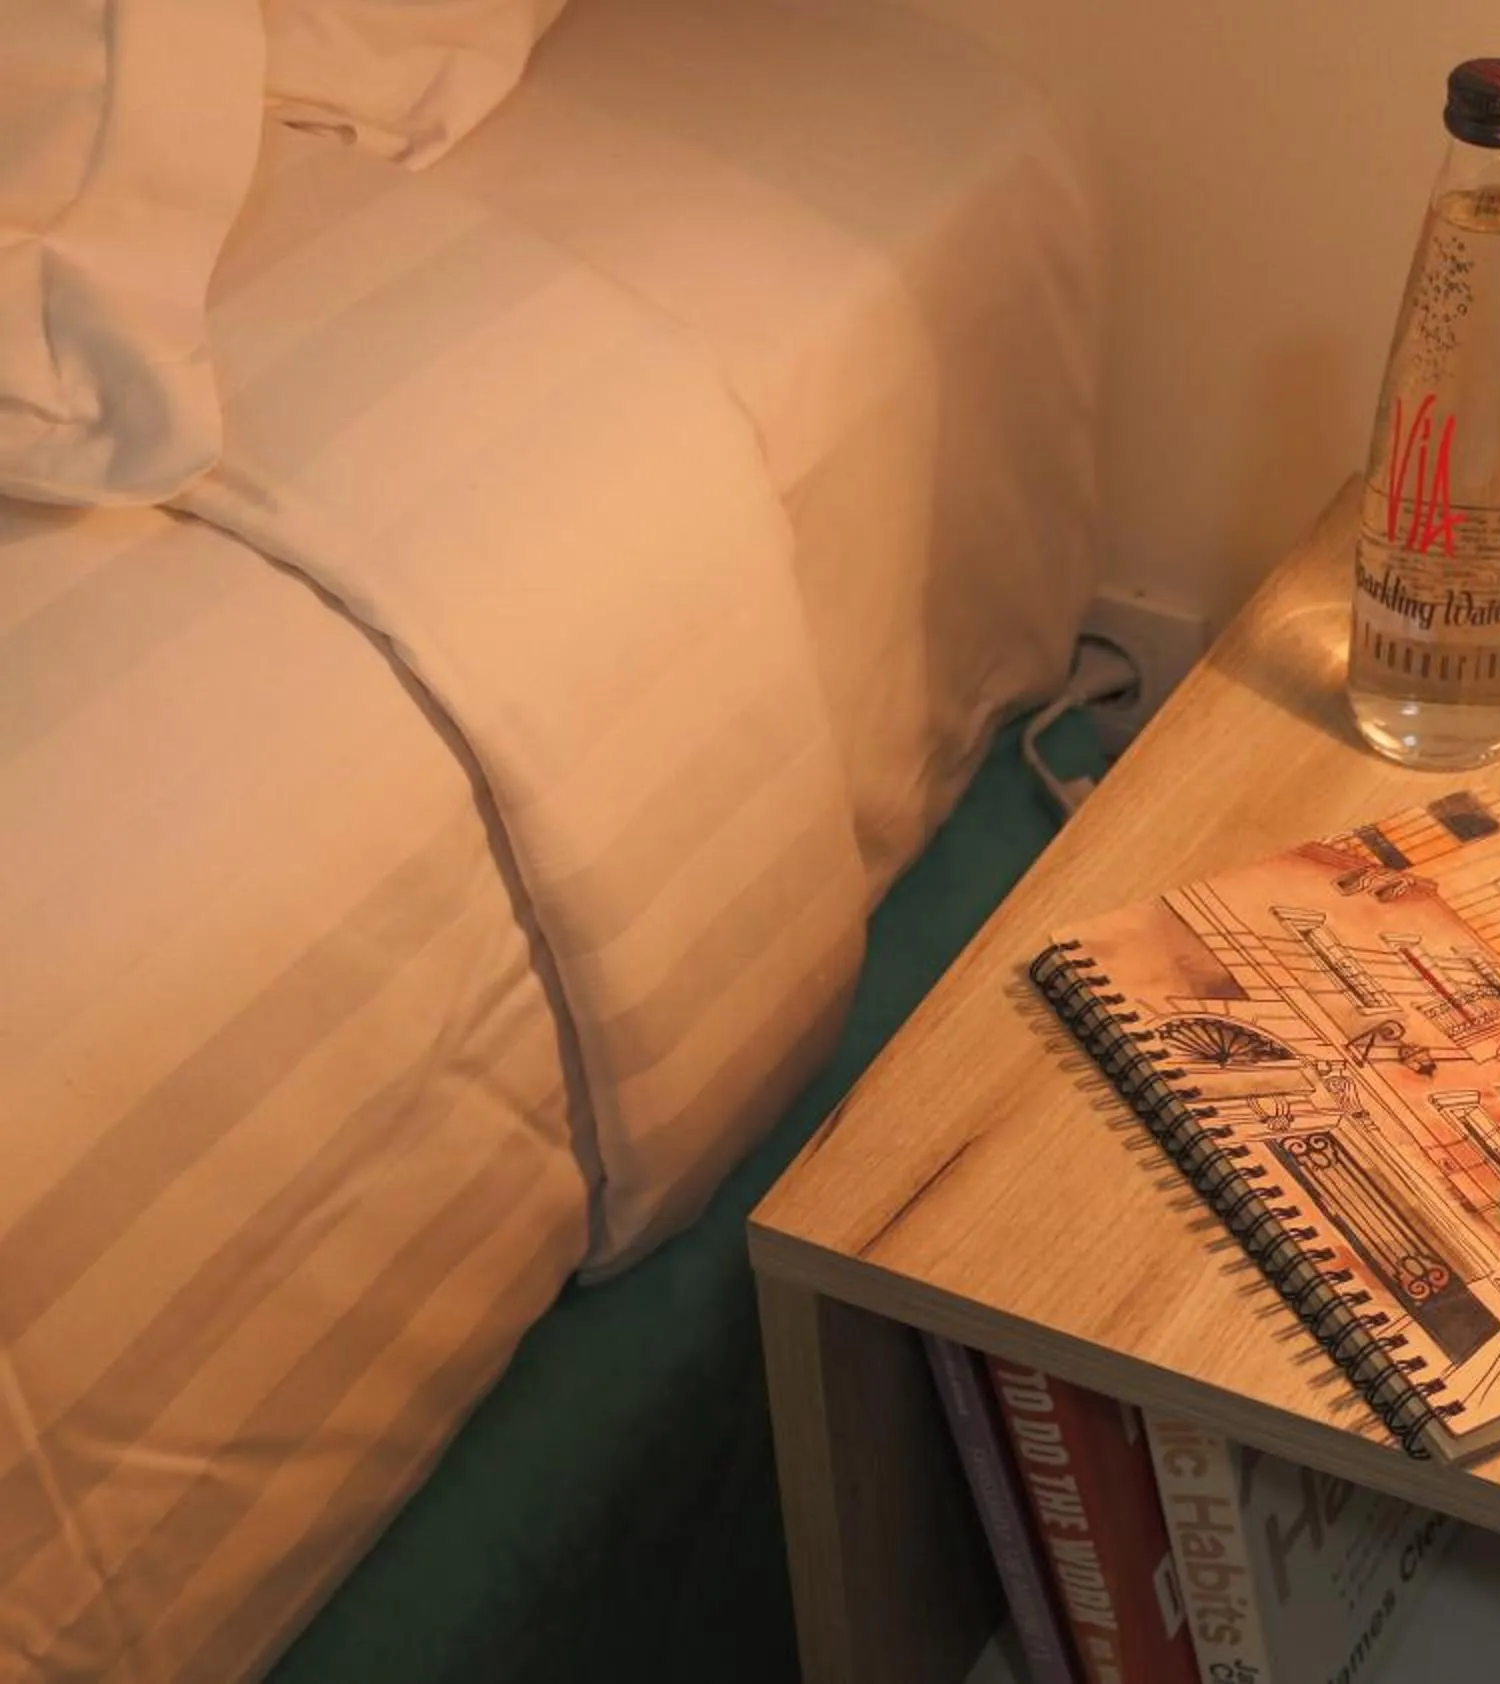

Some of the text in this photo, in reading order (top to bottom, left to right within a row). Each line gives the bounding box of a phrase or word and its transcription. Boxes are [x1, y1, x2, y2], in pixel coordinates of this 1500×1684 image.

[1387, 394, 1466, 557] ViA
[1014, 1414, 1070, 1466] DO
[1030, 1473, 1089, 1533] THE
[1051, 1537, 1119, 1630] WORK
[1171, 1493, 1249, 1648] Habits
[1328, 1588, 1396, 1684] ames
